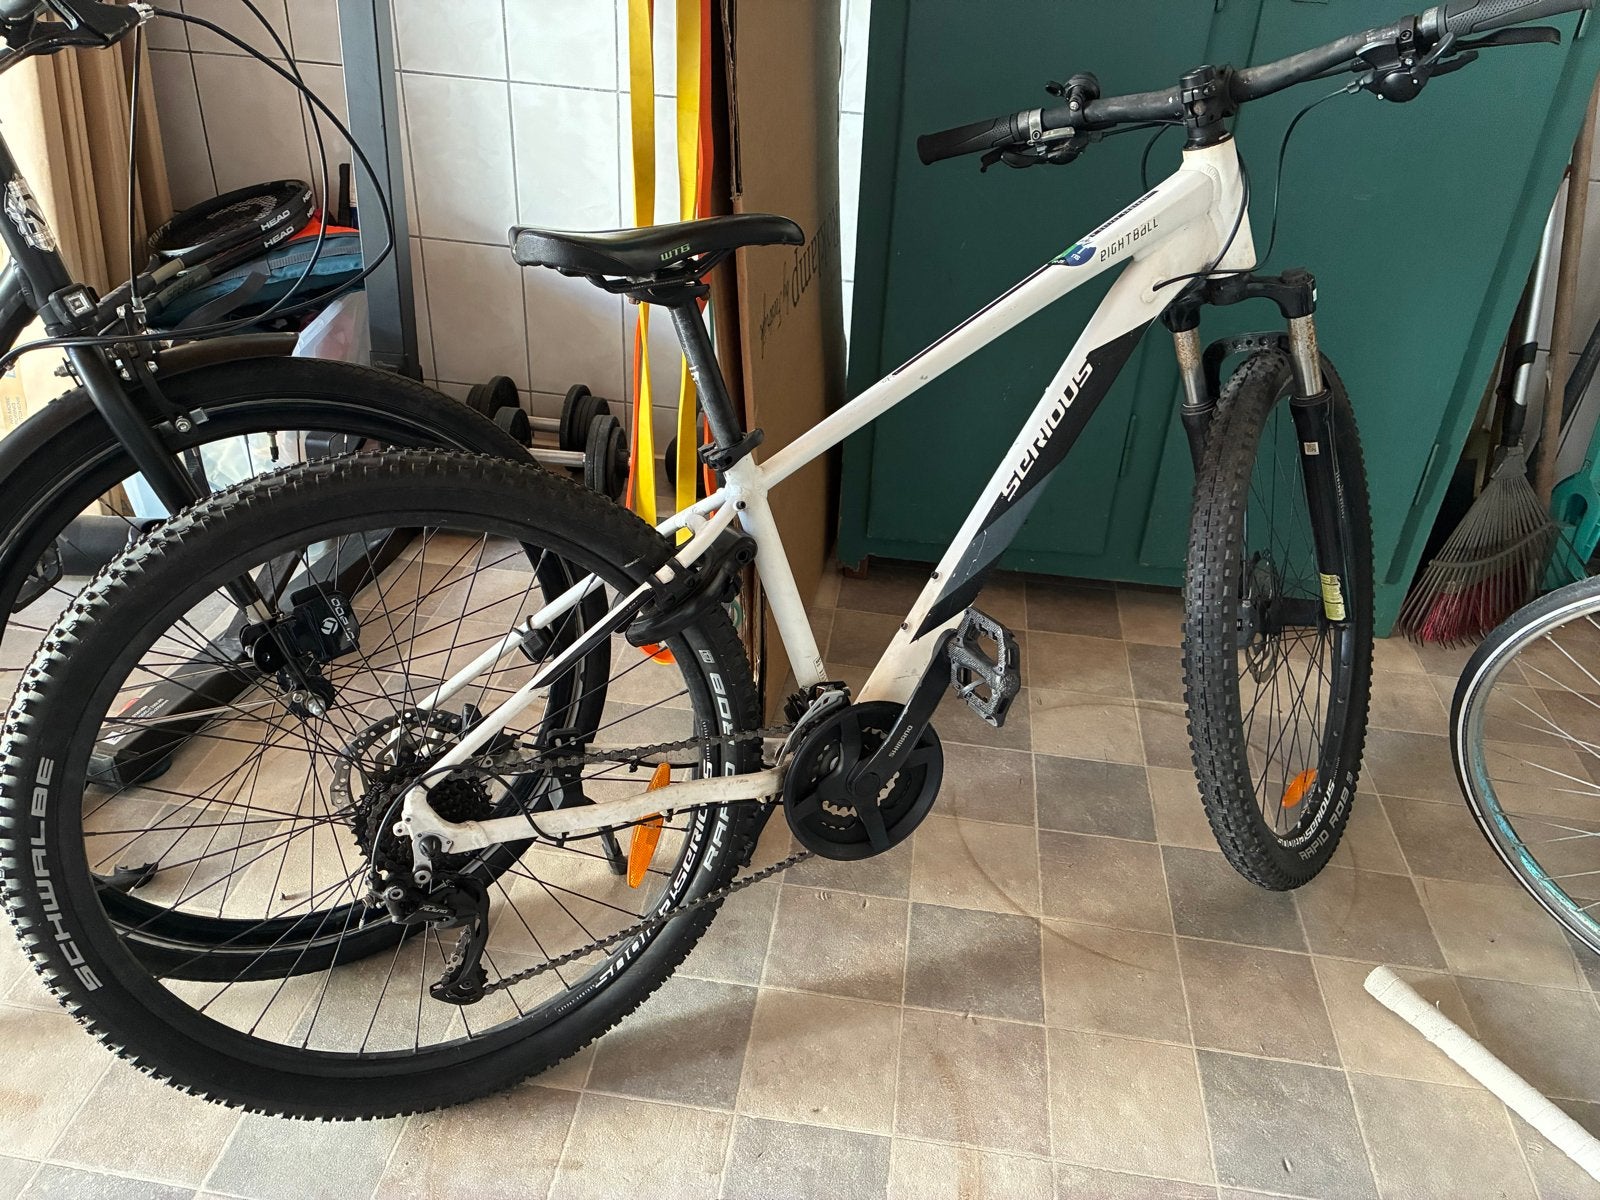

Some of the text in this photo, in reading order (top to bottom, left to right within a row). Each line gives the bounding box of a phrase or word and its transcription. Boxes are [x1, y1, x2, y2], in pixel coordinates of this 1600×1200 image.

[260, 209, 291, 232] HEAD
[264, 226, 295, 249] HEAD
[660, 243, 691, 261] WTB
[1002, 363, 1094, 502] SERIOUS
[888, 725, 914, 758] SHIMANO
[703, 761, 736, 872] RAPD
[1299, 787, 1350, 860] RAPID ROB
[31, 756, 104, 992] SCHWALBE
